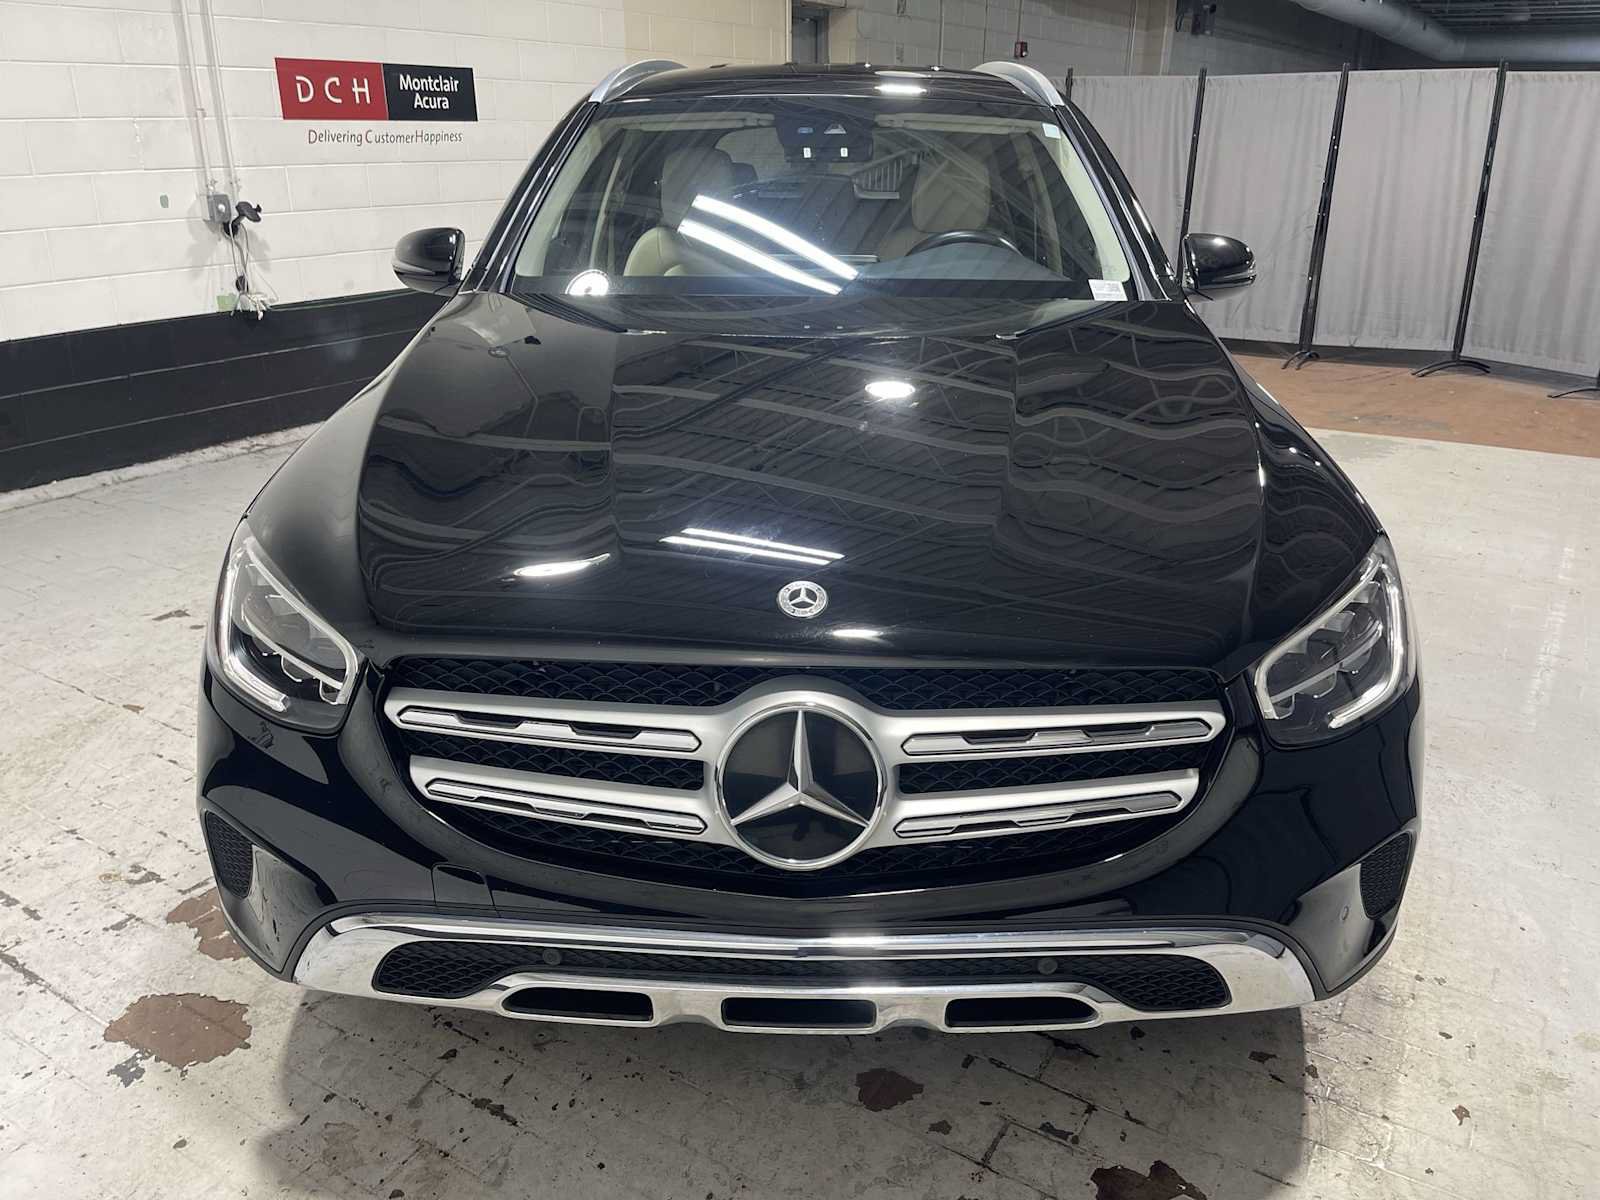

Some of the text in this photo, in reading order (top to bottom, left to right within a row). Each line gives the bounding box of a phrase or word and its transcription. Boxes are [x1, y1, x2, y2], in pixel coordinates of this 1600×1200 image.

[400, 74, 459, 93] Montclair
[414, 93, 449, 109] Acura
[308, 129, 462, 146] Delivering Customer Happiness
